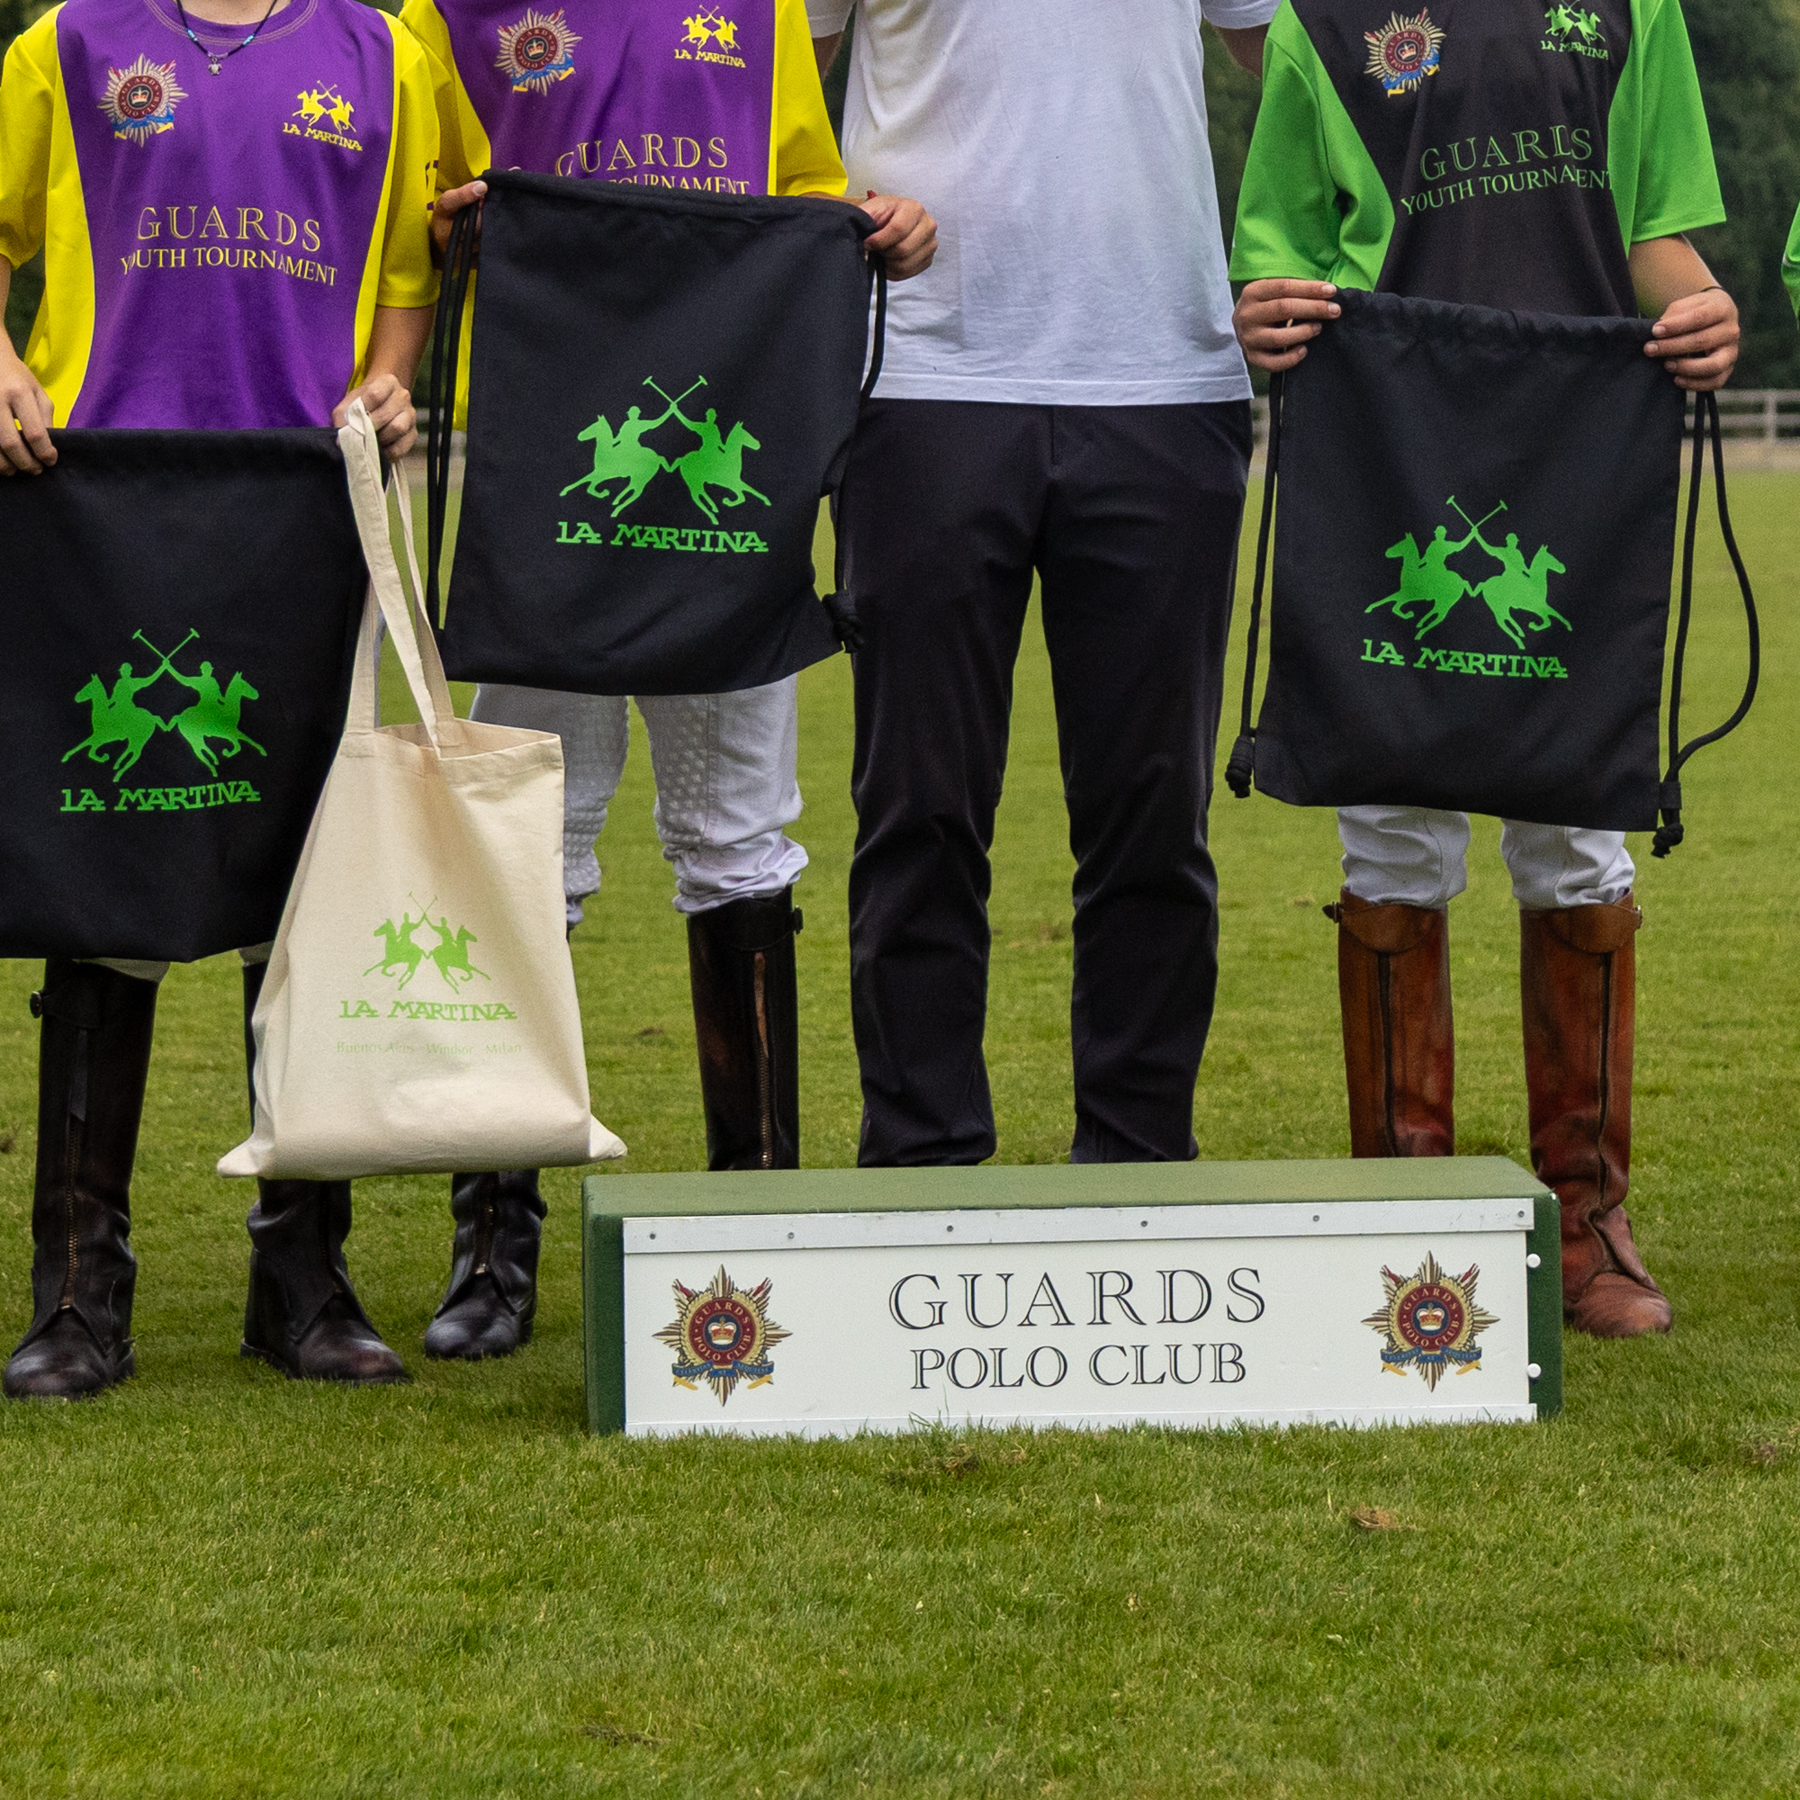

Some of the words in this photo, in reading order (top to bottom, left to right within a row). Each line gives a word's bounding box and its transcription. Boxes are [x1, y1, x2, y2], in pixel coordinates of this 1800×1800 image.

[674, 49, 692, 60] LA
[695, 50, 746, 68] MARTINA
[1540, 40, 1556, 52] LA
[283, 122, 301, 135] LA
[304, 127, 363, 151] MARTINA
[1400, 178, 1476, 215] YOUTH
[136, 205, 321, 252] GUARDS
[193, 246, 338, 287] TOURNAMENT
[556, 521, 602, 544] LA
[610, 524, 769, 553] MARTINA
[1360, 638, 1405, 666] LA
[1413, 647, 1568, 679] MARTINA
[60, 788, 106, 812] LA
[114, 780, 261, 811] MARTINA
[339, 999, 380, 1019] LA
[387, 999, 518, 1022] MARTINA
[337, 1041, 382, 1053] Buenos
[426, 1042, 472, 1055] Windsor
[694, 1301, 751, 1325] GUARDS
[888, 1267, 1266, 1330] GUARDS
[1403, 1287, 1460, 1311] GUARDS
[693, 1336, 721, 1361] POLO
[726, 1333, 752, 1361] CLUB
[1402, 1321, 1429, 1348] POLO
[1434, 1319, 1460, 1346] CLUB
[910, 1345, 1068, 1390] POLO
[1089, 1342, 1246, 1386] CLUB
